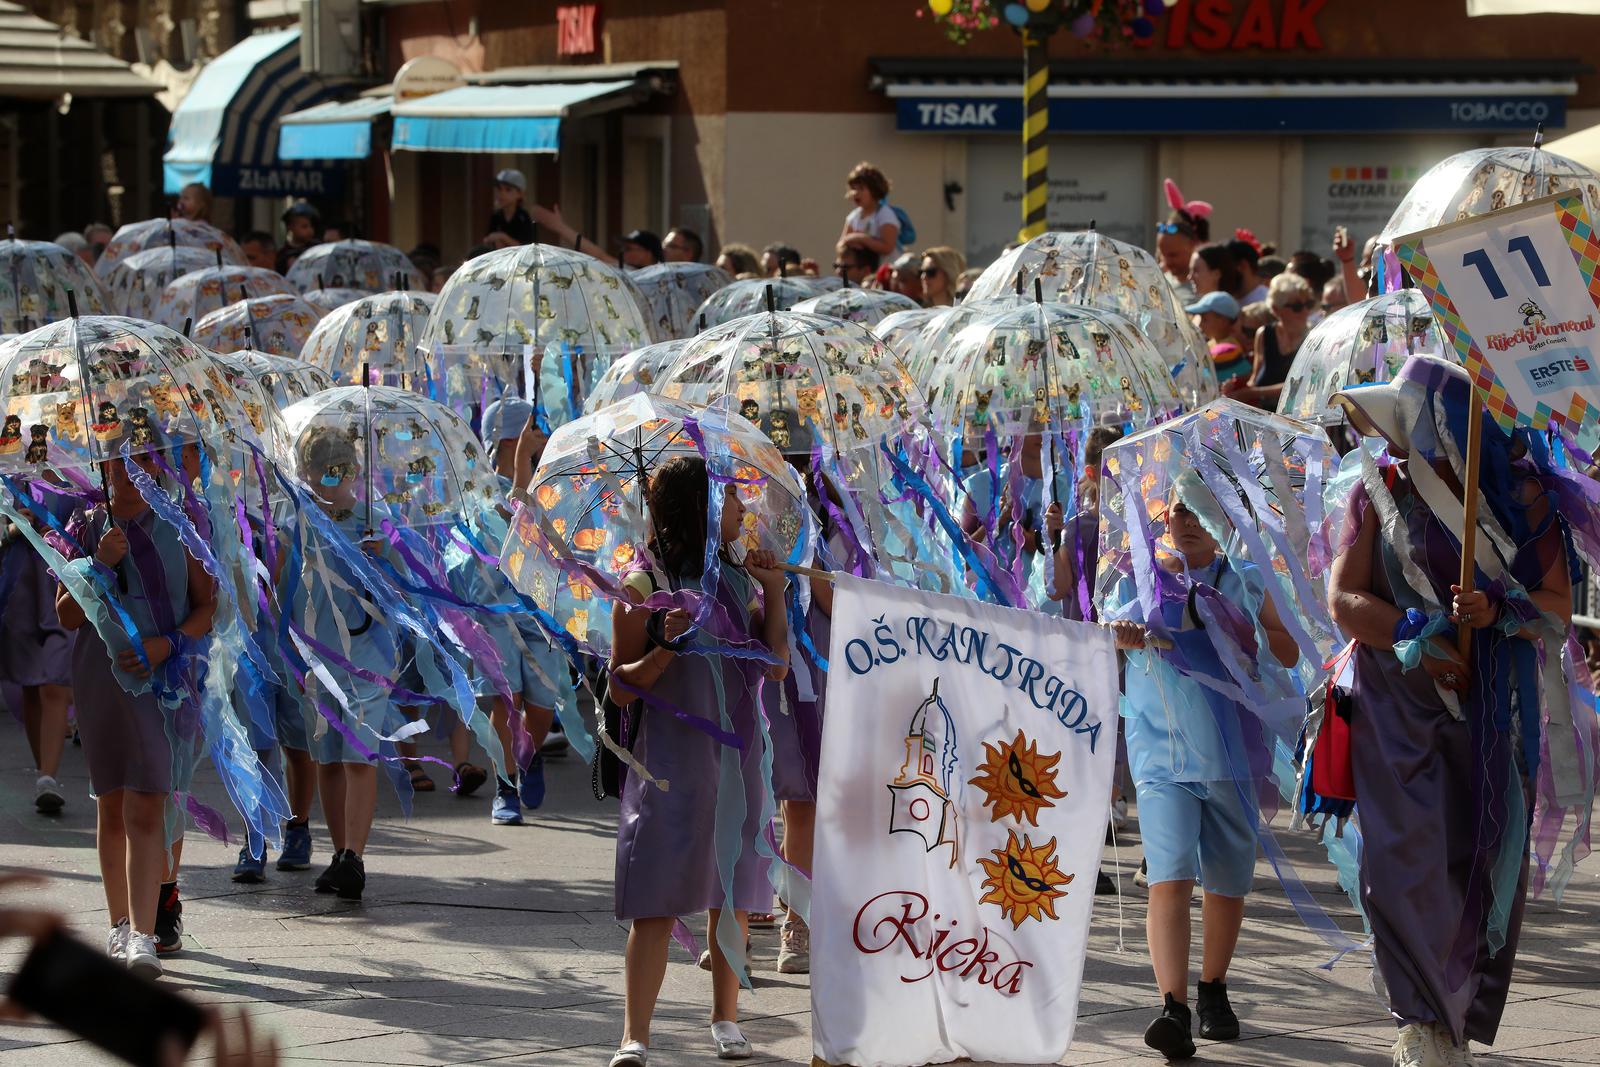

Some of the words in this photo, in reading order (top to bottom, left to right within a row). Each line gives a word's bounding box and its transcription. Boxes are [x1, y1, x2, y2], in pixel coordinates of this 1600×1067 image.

[917, 103, 998, 126] TISAK
[1450, 102, 1549, 121] TOBACCO
[239, 168, 325, 193] ZLATAR
[1328, 183, 1386, 198] CENTAR
[1463, 235, 1552, 300] 11
[1485, 326, 1538, 352] Riječki
[1534, 314, 1596, 337] Karneval
[1529, 359, 1575, 381] ERSTE
[1536, 379, 1555, 388] Bank
[852, 890, 1034, 995] Rijeka
